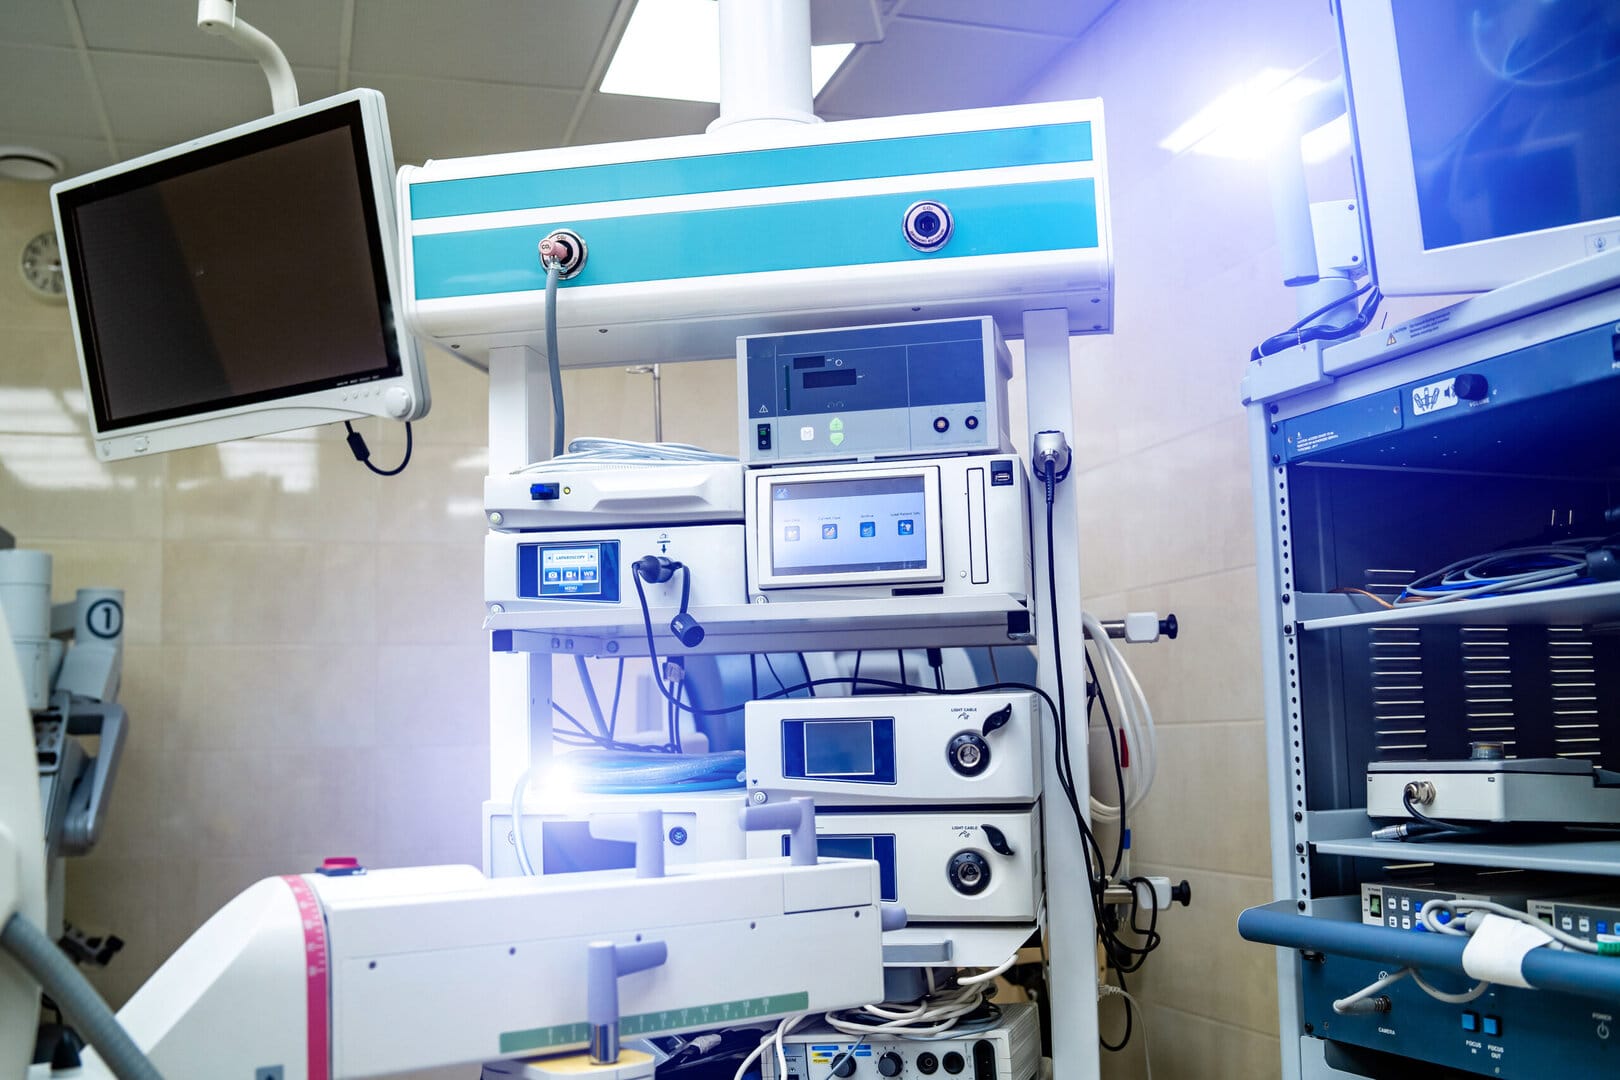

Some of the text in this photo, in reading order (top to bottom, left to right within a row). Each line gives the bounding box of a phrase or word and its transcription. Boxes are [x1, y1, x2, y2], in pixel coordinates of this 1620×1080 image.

[1378, 1026, 1396, 1035] CAMERA
[1465, 1040, 1482, 1049] FOCUS
[1487, 1044, 1504, 1053] FOCUS
[1490, 1052, 1501, 1060] OUT
